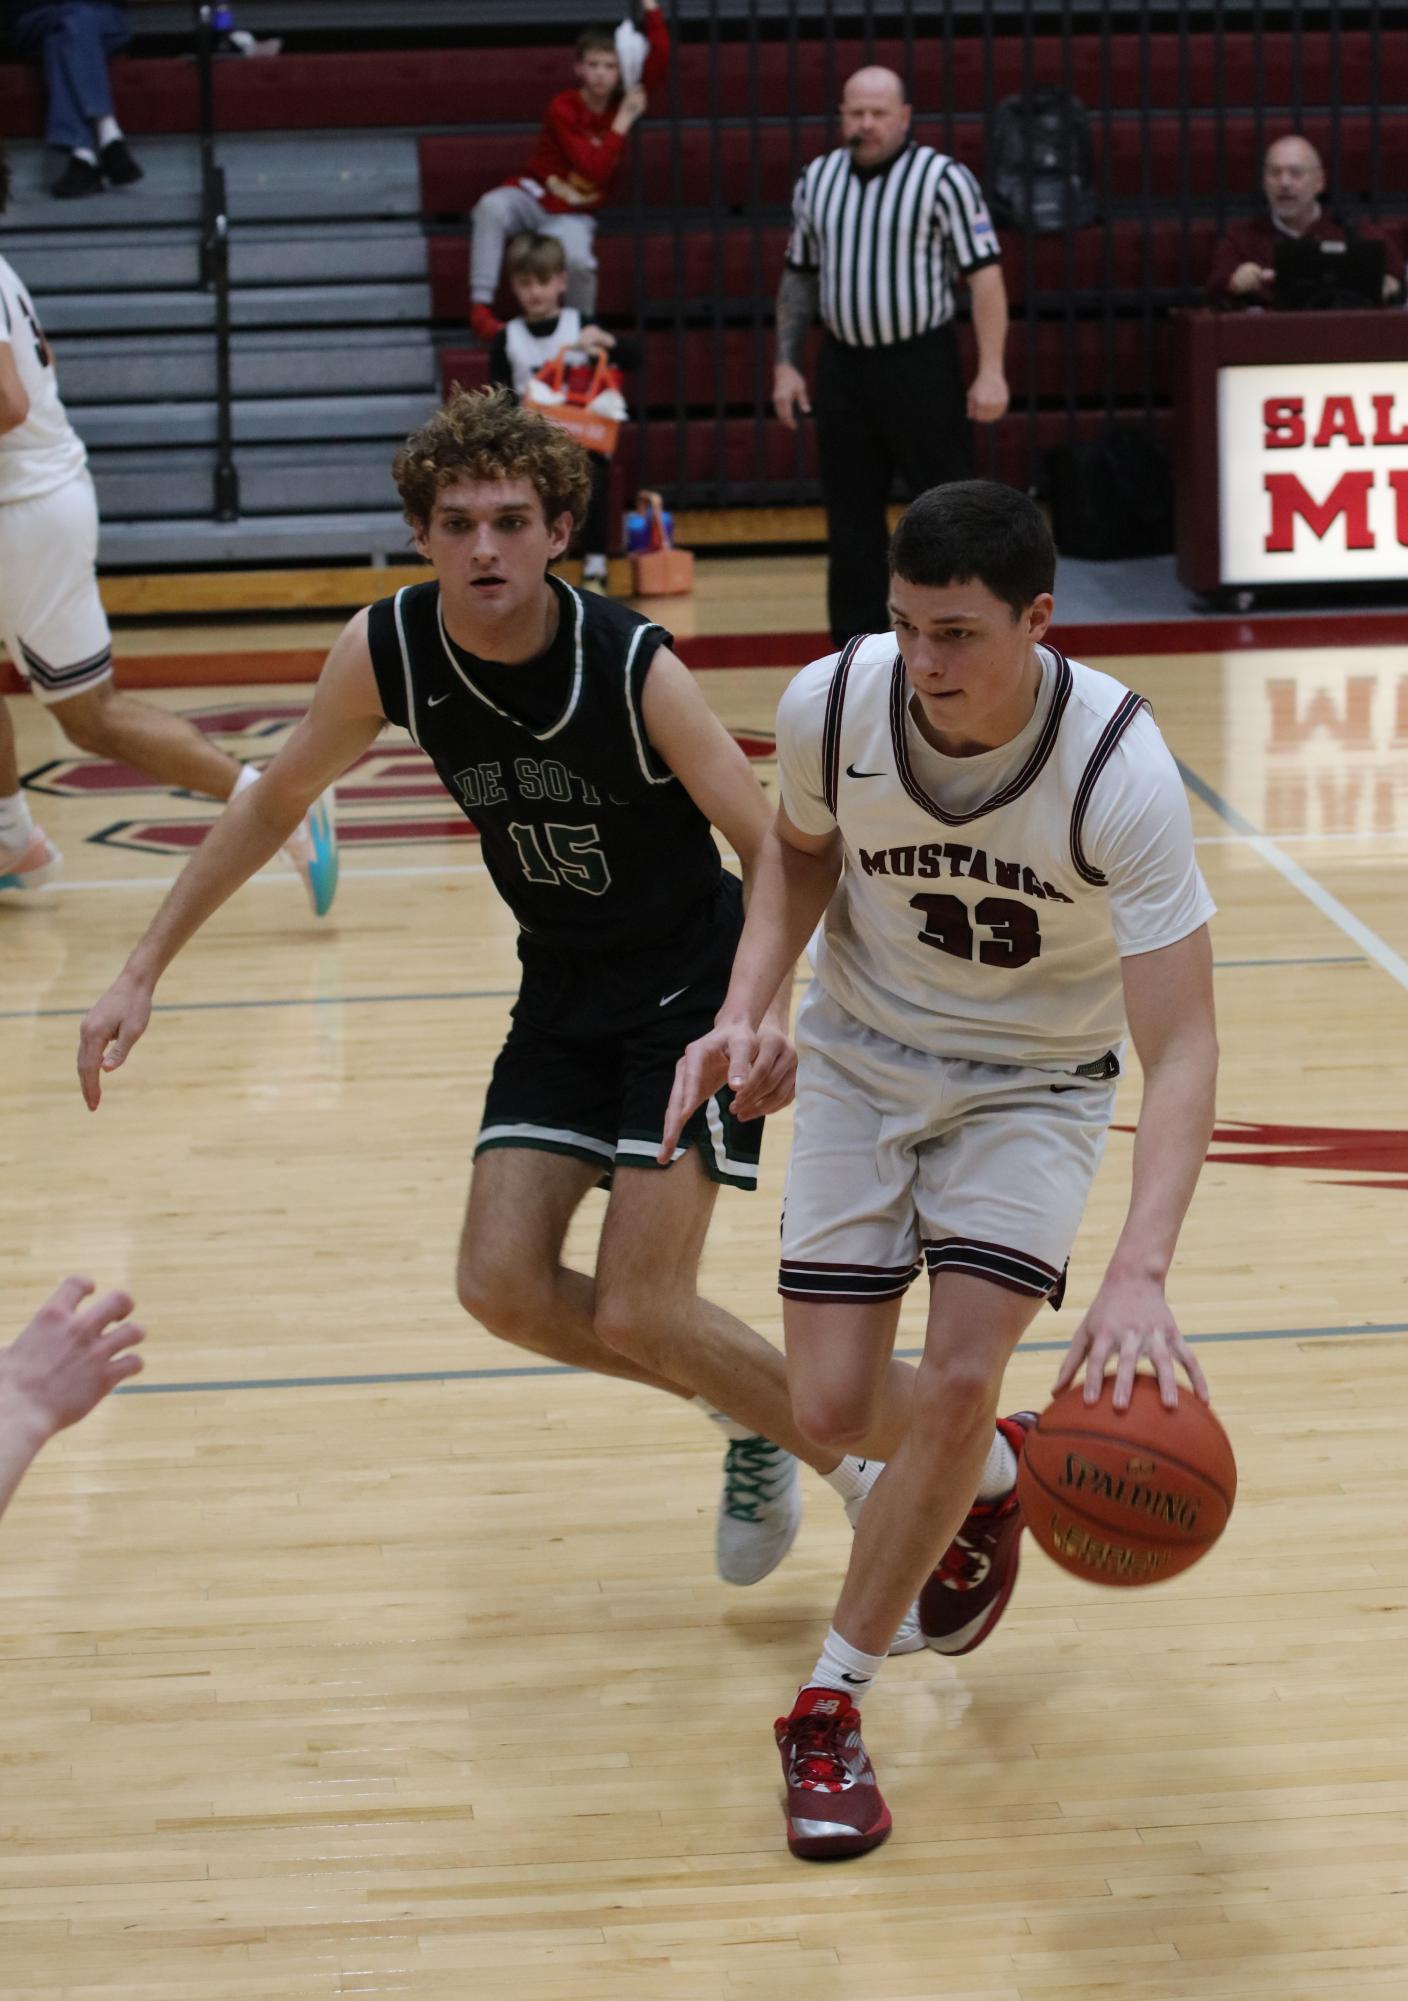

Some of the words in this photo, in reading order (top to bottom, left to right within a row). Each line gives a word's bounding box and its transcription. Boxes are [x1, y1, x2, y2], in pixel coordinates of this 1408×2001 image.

[1263, 470, 1408, 553] M
[453, 761, 508, 807] DE
[514, 757, 630, 806] SOT
[508, 821, 612, 896] 15
[908, 892, 1042, 969] 33
[1057, 1451, 1199, 1531] SPALDING
